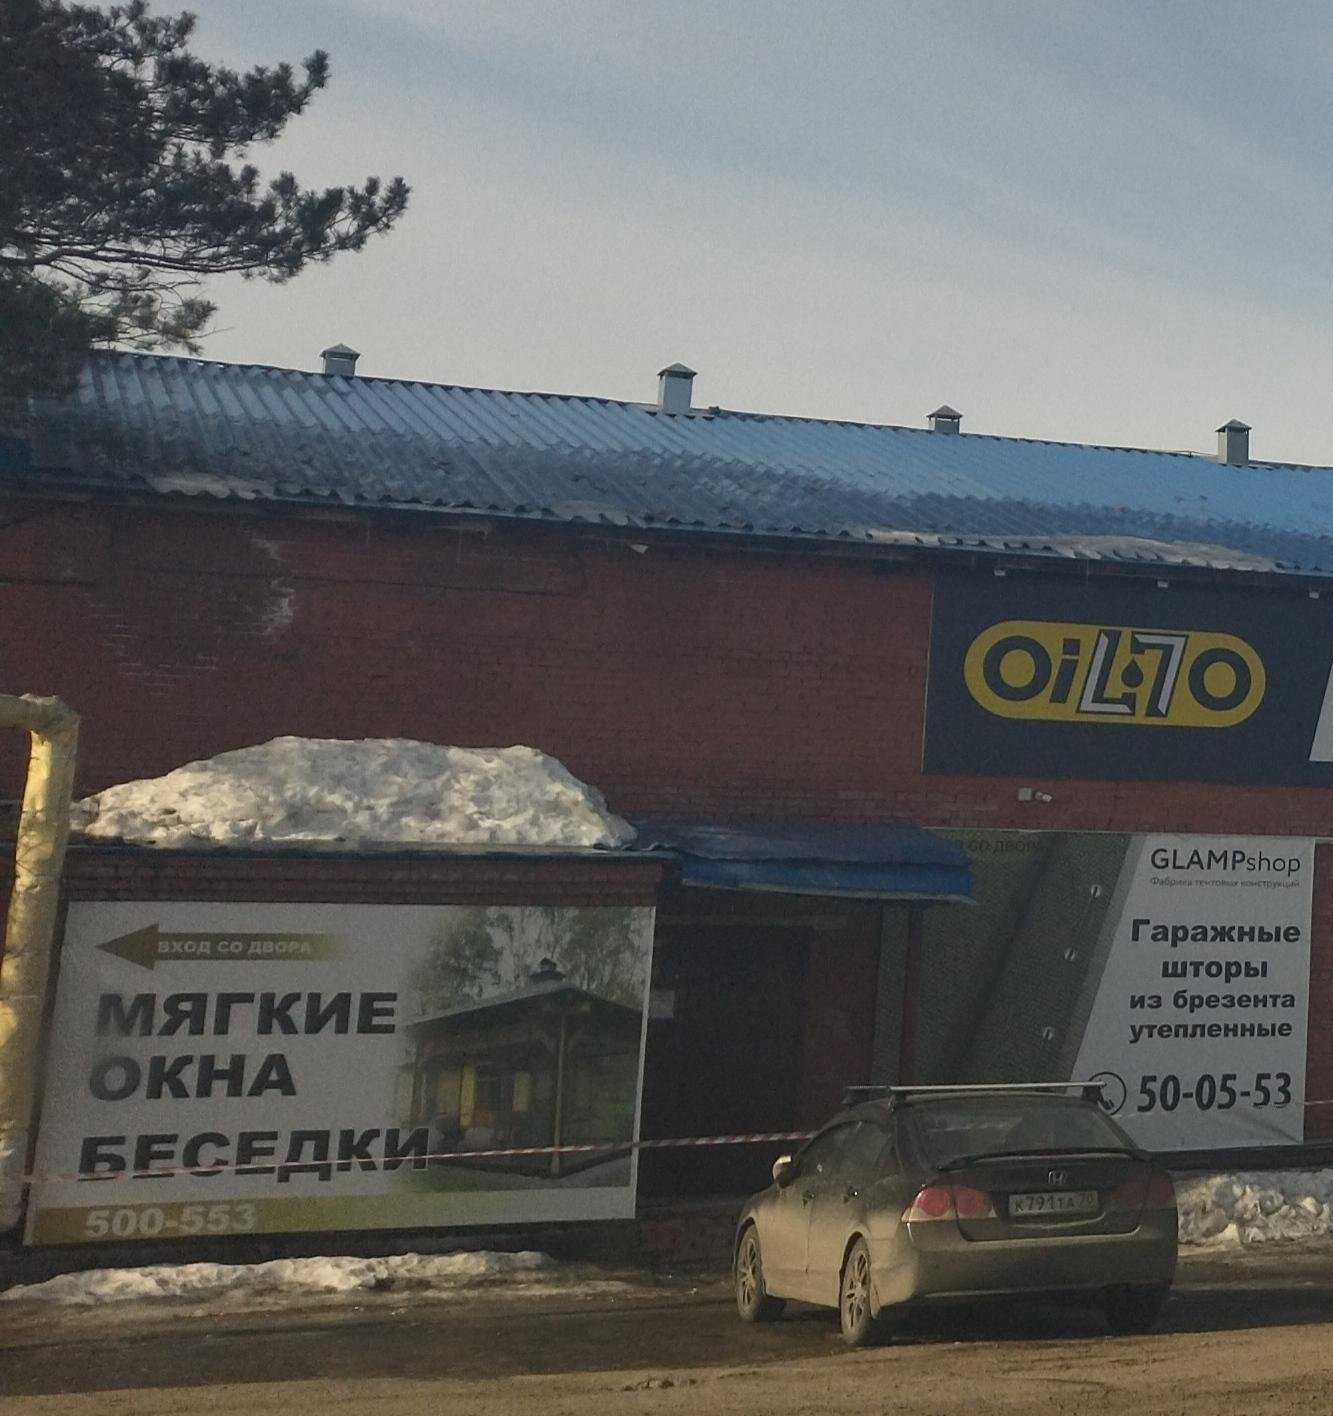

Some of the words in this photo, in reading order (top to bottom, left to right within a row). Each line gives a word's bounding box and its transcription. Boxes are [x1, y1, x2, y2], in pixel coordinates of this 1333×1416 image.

[1151, 848, 1301, 877] GLAMPshop
[158, 940, 211, 954] ВХОД
[218, 941, 243, 953] СО
[247, 941, 312, 955] ДВОРА
[1131, 919, 1300, 947] Гаражные
[1161, 961, 1268, 983] шторы
[100, 991, 398, 1037] МЯГКИЕ
[1130, 994, 1162, 1009] из
[1173, 989, 1295, 1013] брезента
[1129, 1022, 1292, 1044] утепленные
[88, 1052, 297, 1100] ОКНА
[1137, 1072, 1291, 1112] 50-05-53
[78, 1127, 430, 1182] БЕСЕДКИ
[86, 1203, 257, 1238] 500-553
